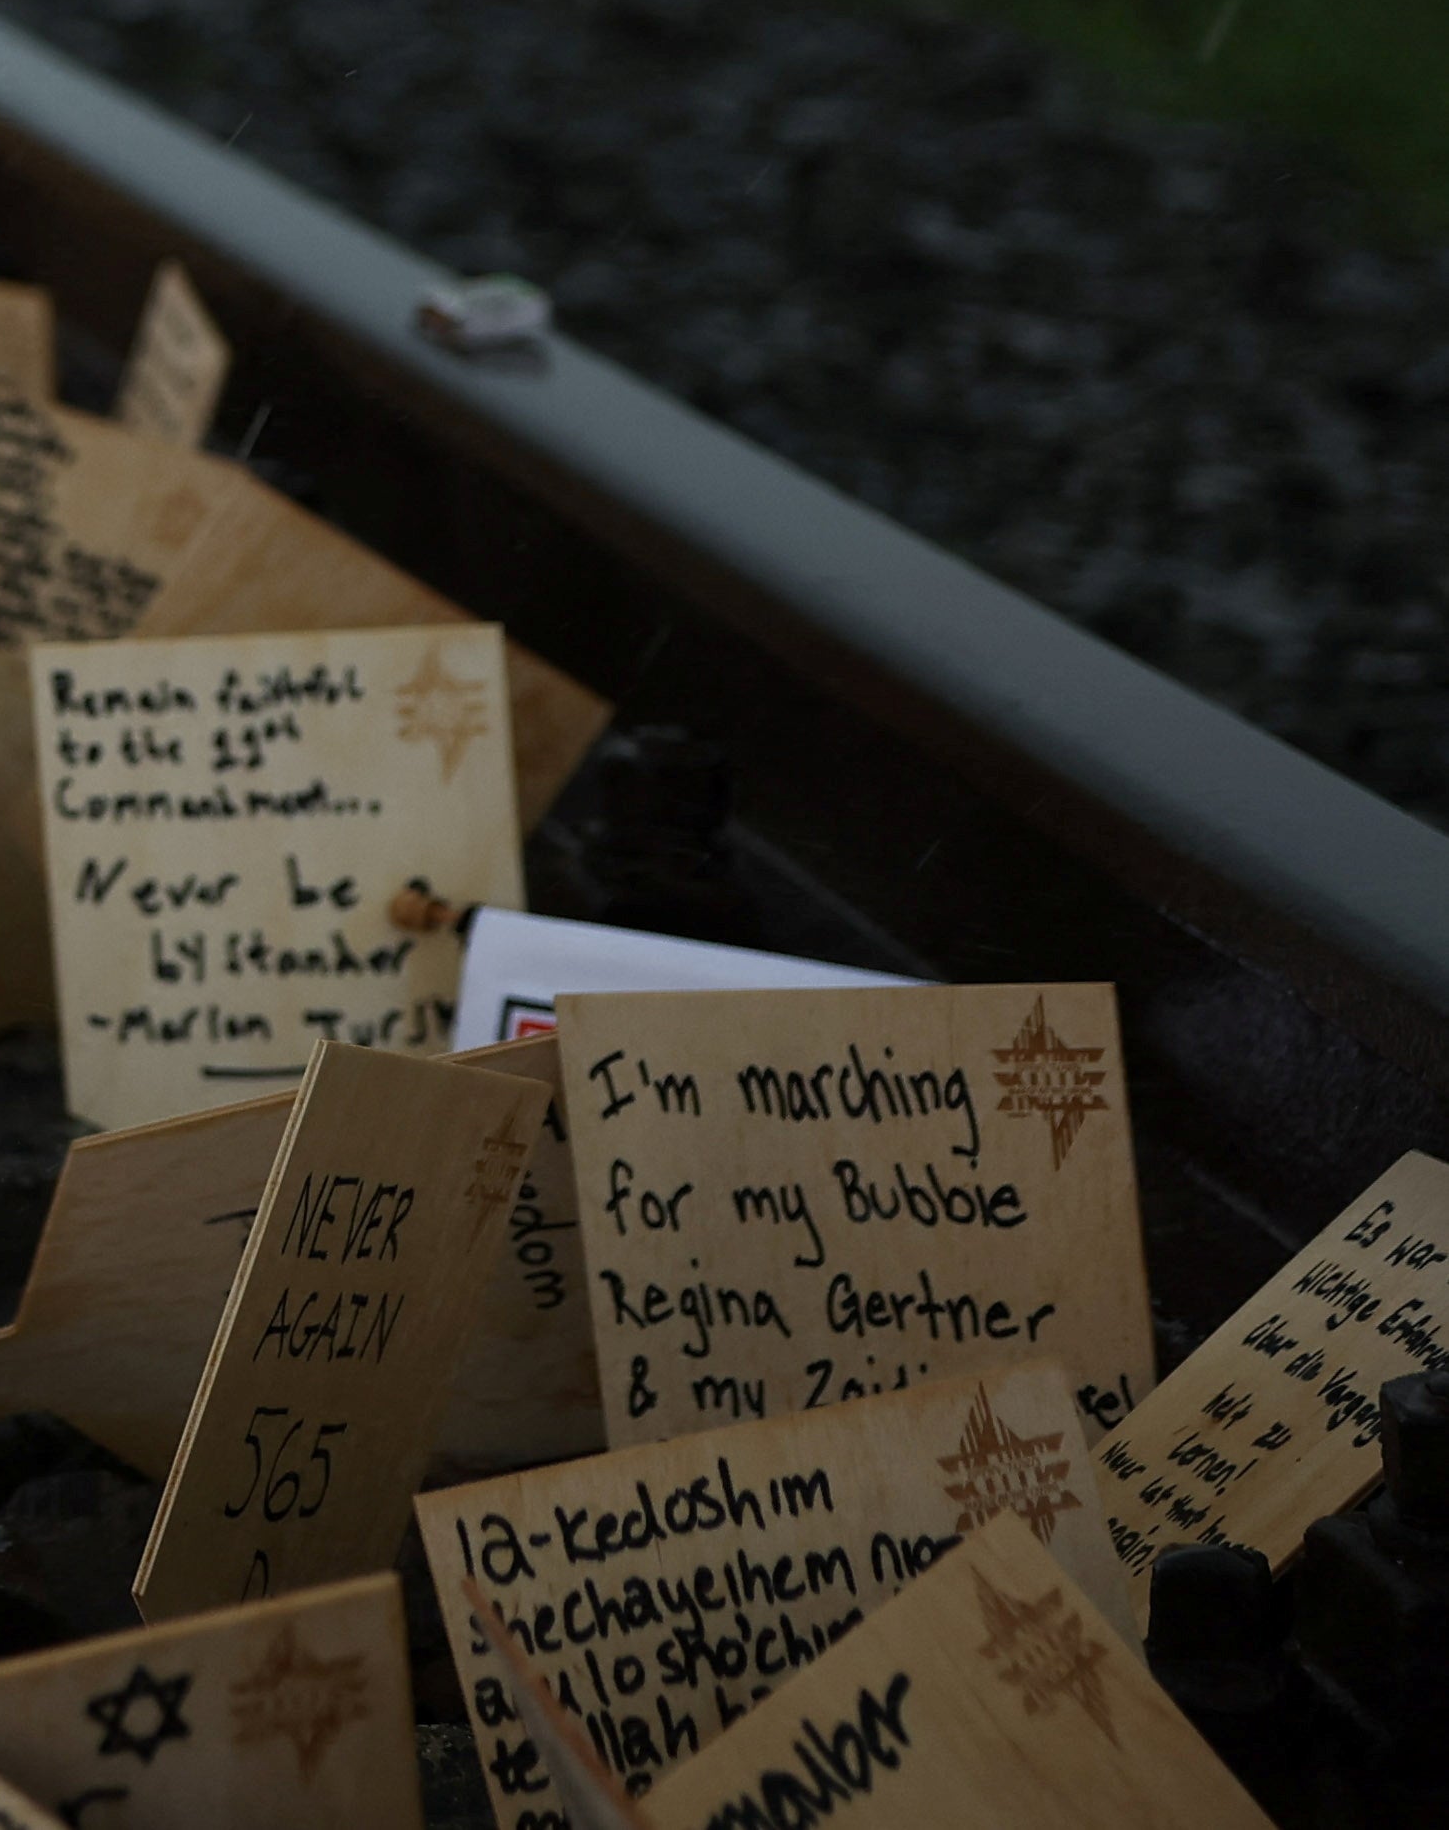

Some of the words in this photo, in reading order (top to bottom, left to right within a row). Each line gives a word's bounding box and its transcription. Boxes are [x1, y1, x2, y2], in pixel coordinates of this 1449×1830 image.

[74, 856, 241, 917] Never
[286, 852, 359, 908] be
[588, 1049, 702, 1120] I'm
[738, 1043, 981, 1159] marching
[280, 1172, 415, 1265] NEVER
[605, 1158, 694, 1237] for
[733, 1180, 826, 1269] my
[833, 1156, 1029, 1229] Bubbie
[1343, 1199, 1395, 1249] Es
[1384, 1234, 1448, 1271] war
[252, 1287, 405, 1364] AGAIN
[599, 1257, 793, 1359] Regina
[825, 1269, 1057, 1344] Gertner
[627, 1354, 657, 1420] &
[692, 1373, 766, 1422] my
[224, 1405, 348, 1522] 565
